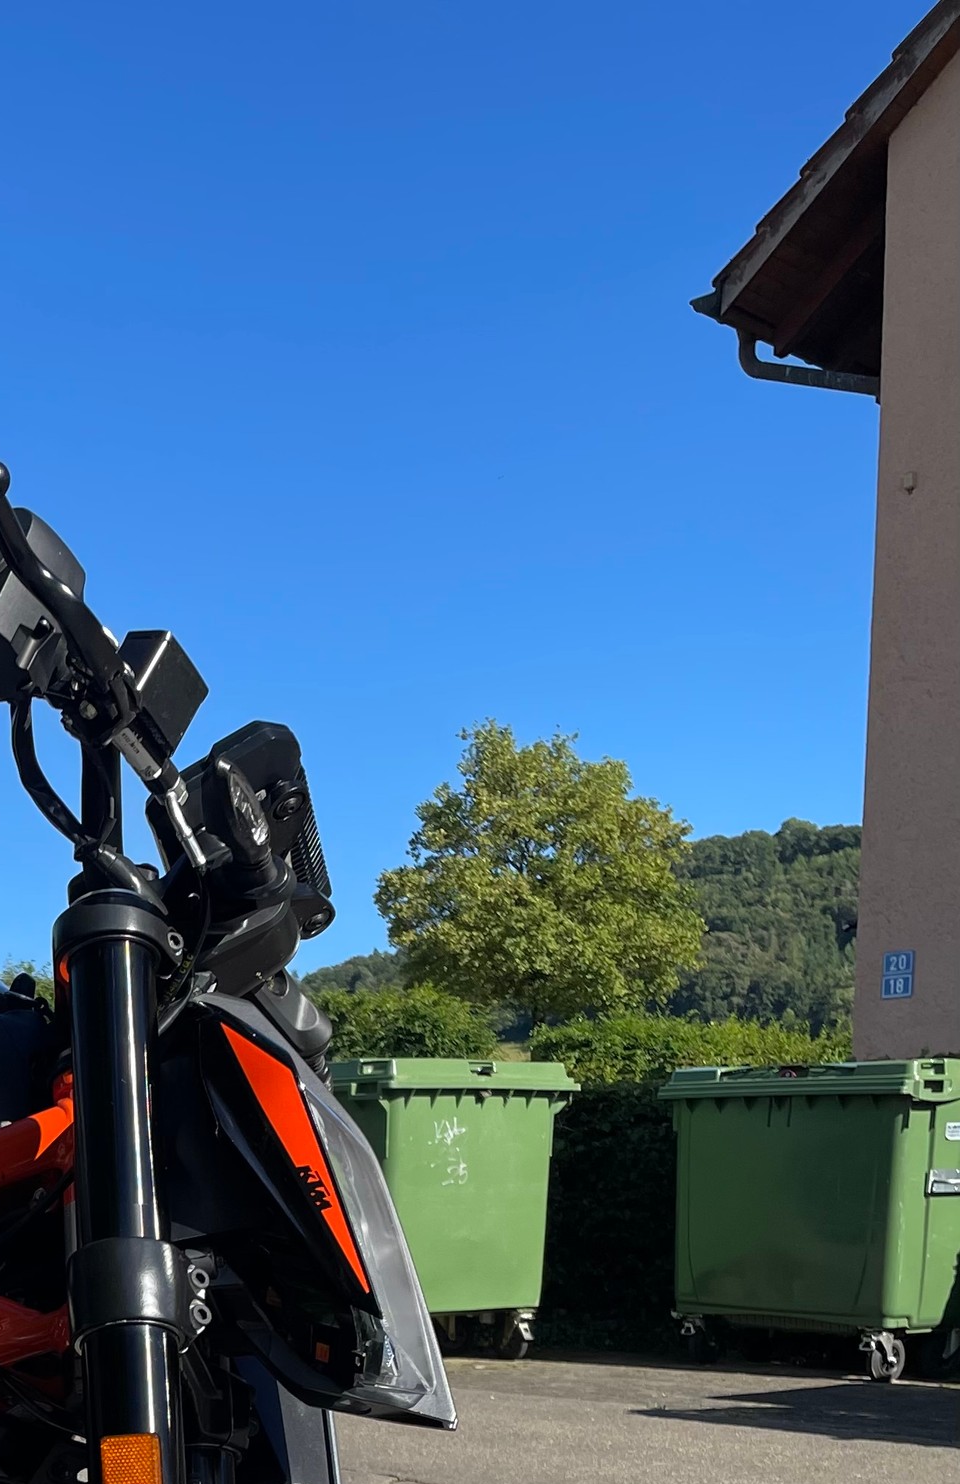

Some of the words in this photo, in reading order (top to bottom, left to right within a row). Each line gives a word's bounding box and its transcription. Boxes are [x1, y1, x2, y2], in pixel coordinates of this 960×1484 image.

[890, 954, 907, 971] 20
[889, 978, 904, 995] 18
[294, 1165, 333, 1209] KTM
